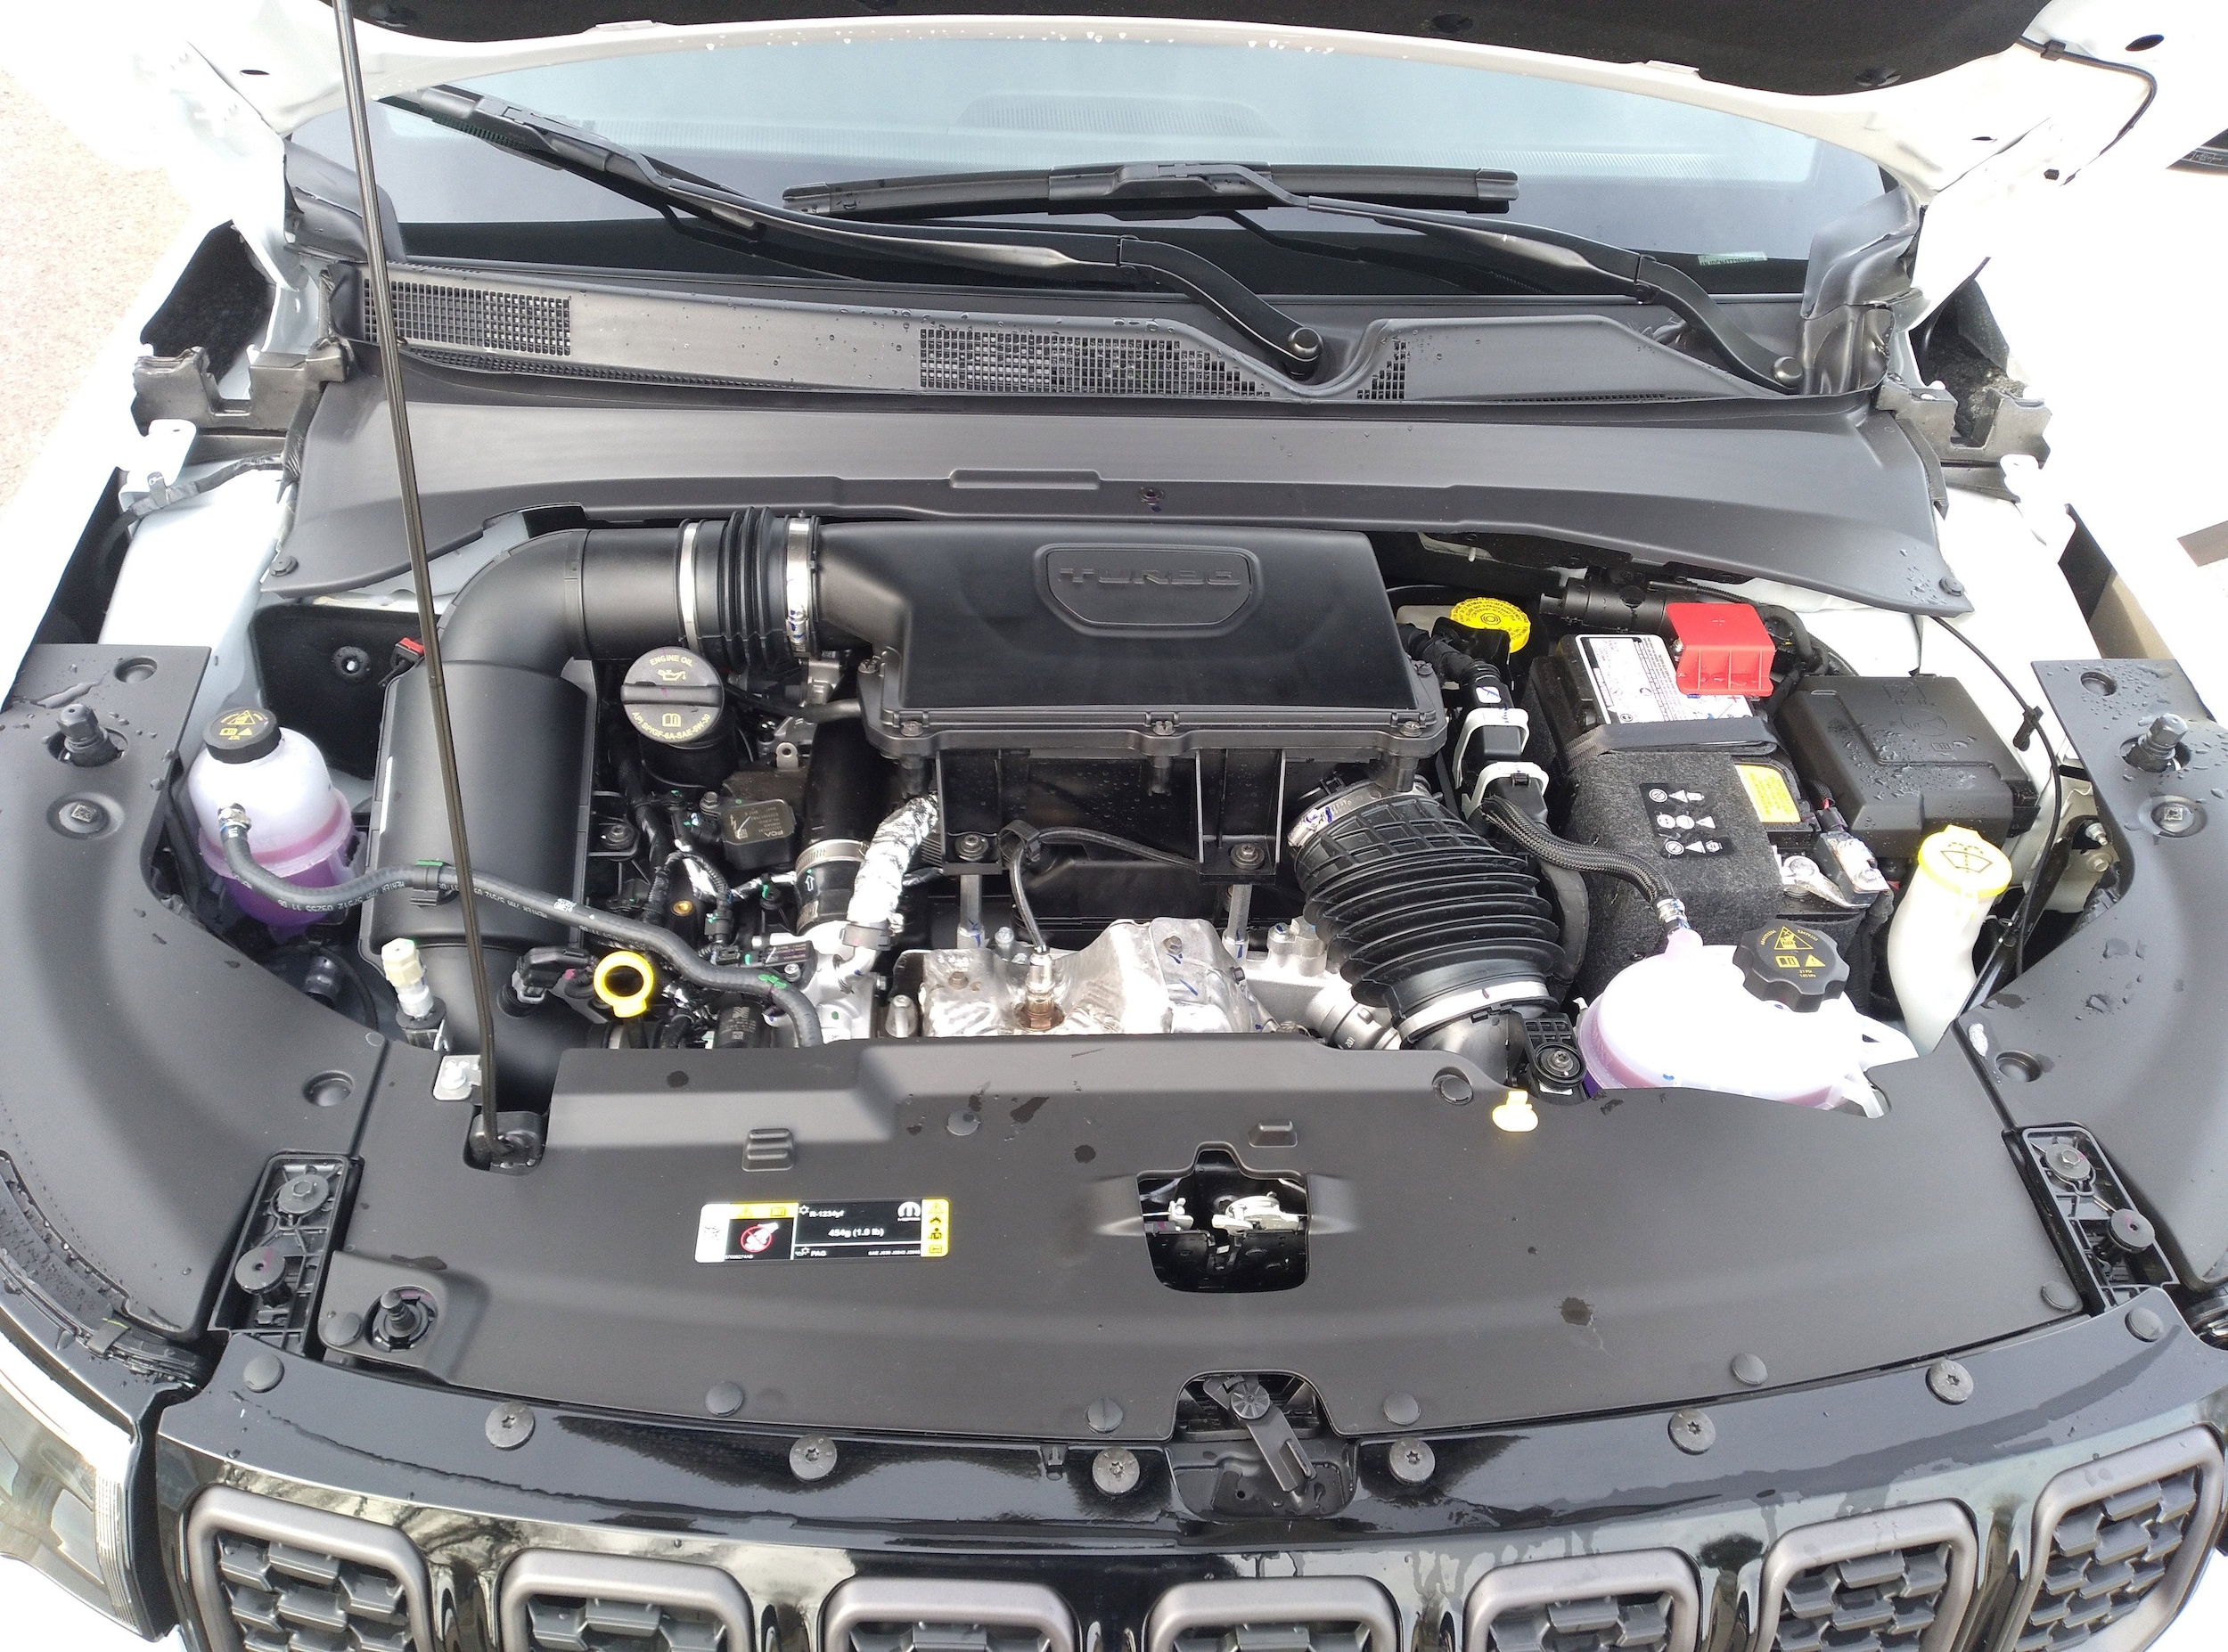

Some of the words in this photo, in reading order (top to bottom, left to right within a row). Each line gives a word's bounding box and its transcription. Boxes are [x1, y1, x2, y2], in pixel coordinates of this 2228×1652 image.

[1058, 568, 1242, 585] TURBO
[650, 655, 679, 667] ENGINE
[681, 656, 693, 667] OIL
[632, 712, 644, 724] API
[809, 1210, 845, 1219] R-1234yf
[828, 1229, 851, 1238] 454g
[853, 1228, 870, 1238] (1.0
[871, 1227, 885, 1238] lb)
[810, 1249, 827, 1257] PAG
